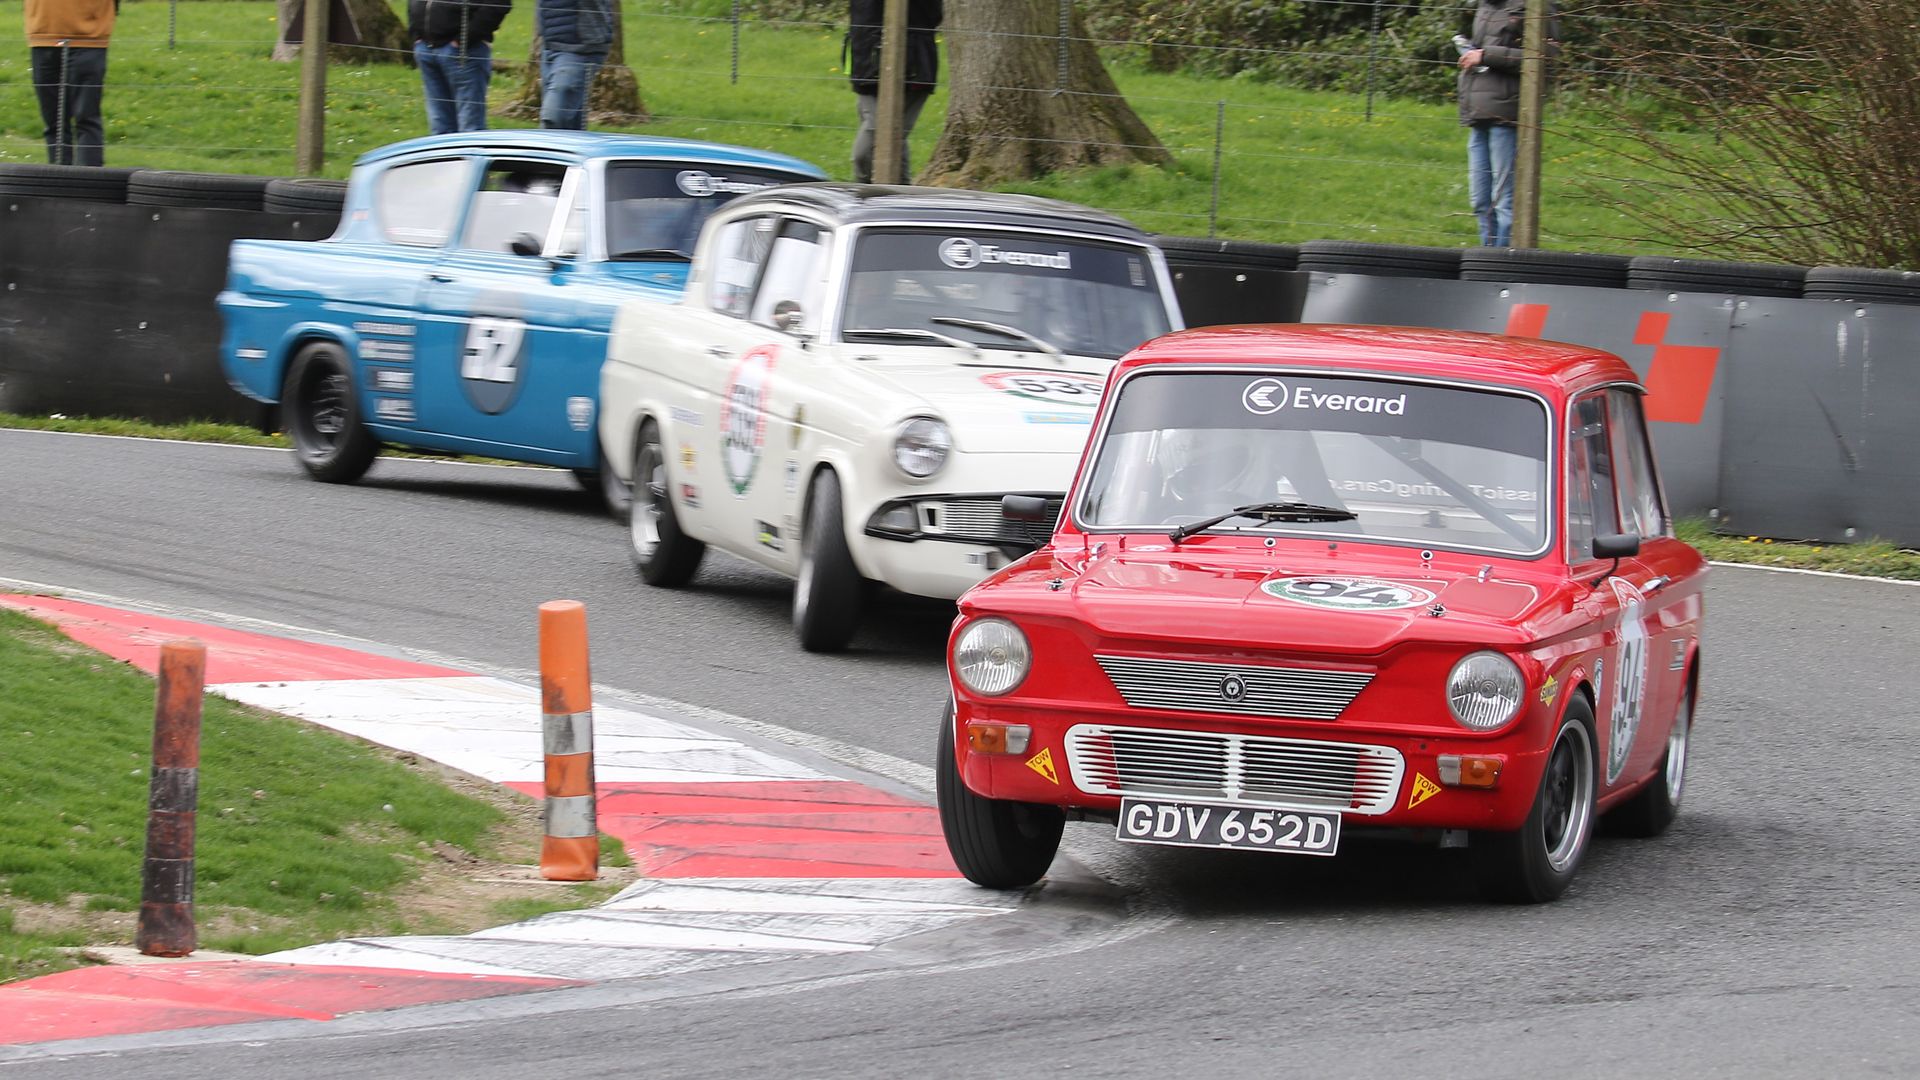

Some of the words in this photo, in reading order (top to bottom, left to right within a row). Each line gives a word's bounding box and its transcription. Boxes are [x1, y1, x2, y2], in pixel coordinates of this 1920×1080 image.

[980, 244, 1072, 270] Everard
[1293, 386, 1407, 416] Everard
[1287, 581, 1400, 604] 94
[1029, 751, 1049, 768] TOW
[1417, 775, 1438, 794] TOW
[1126, 803, 1212, 841] GDV
[1219, 810, 1333, 850] 652D
